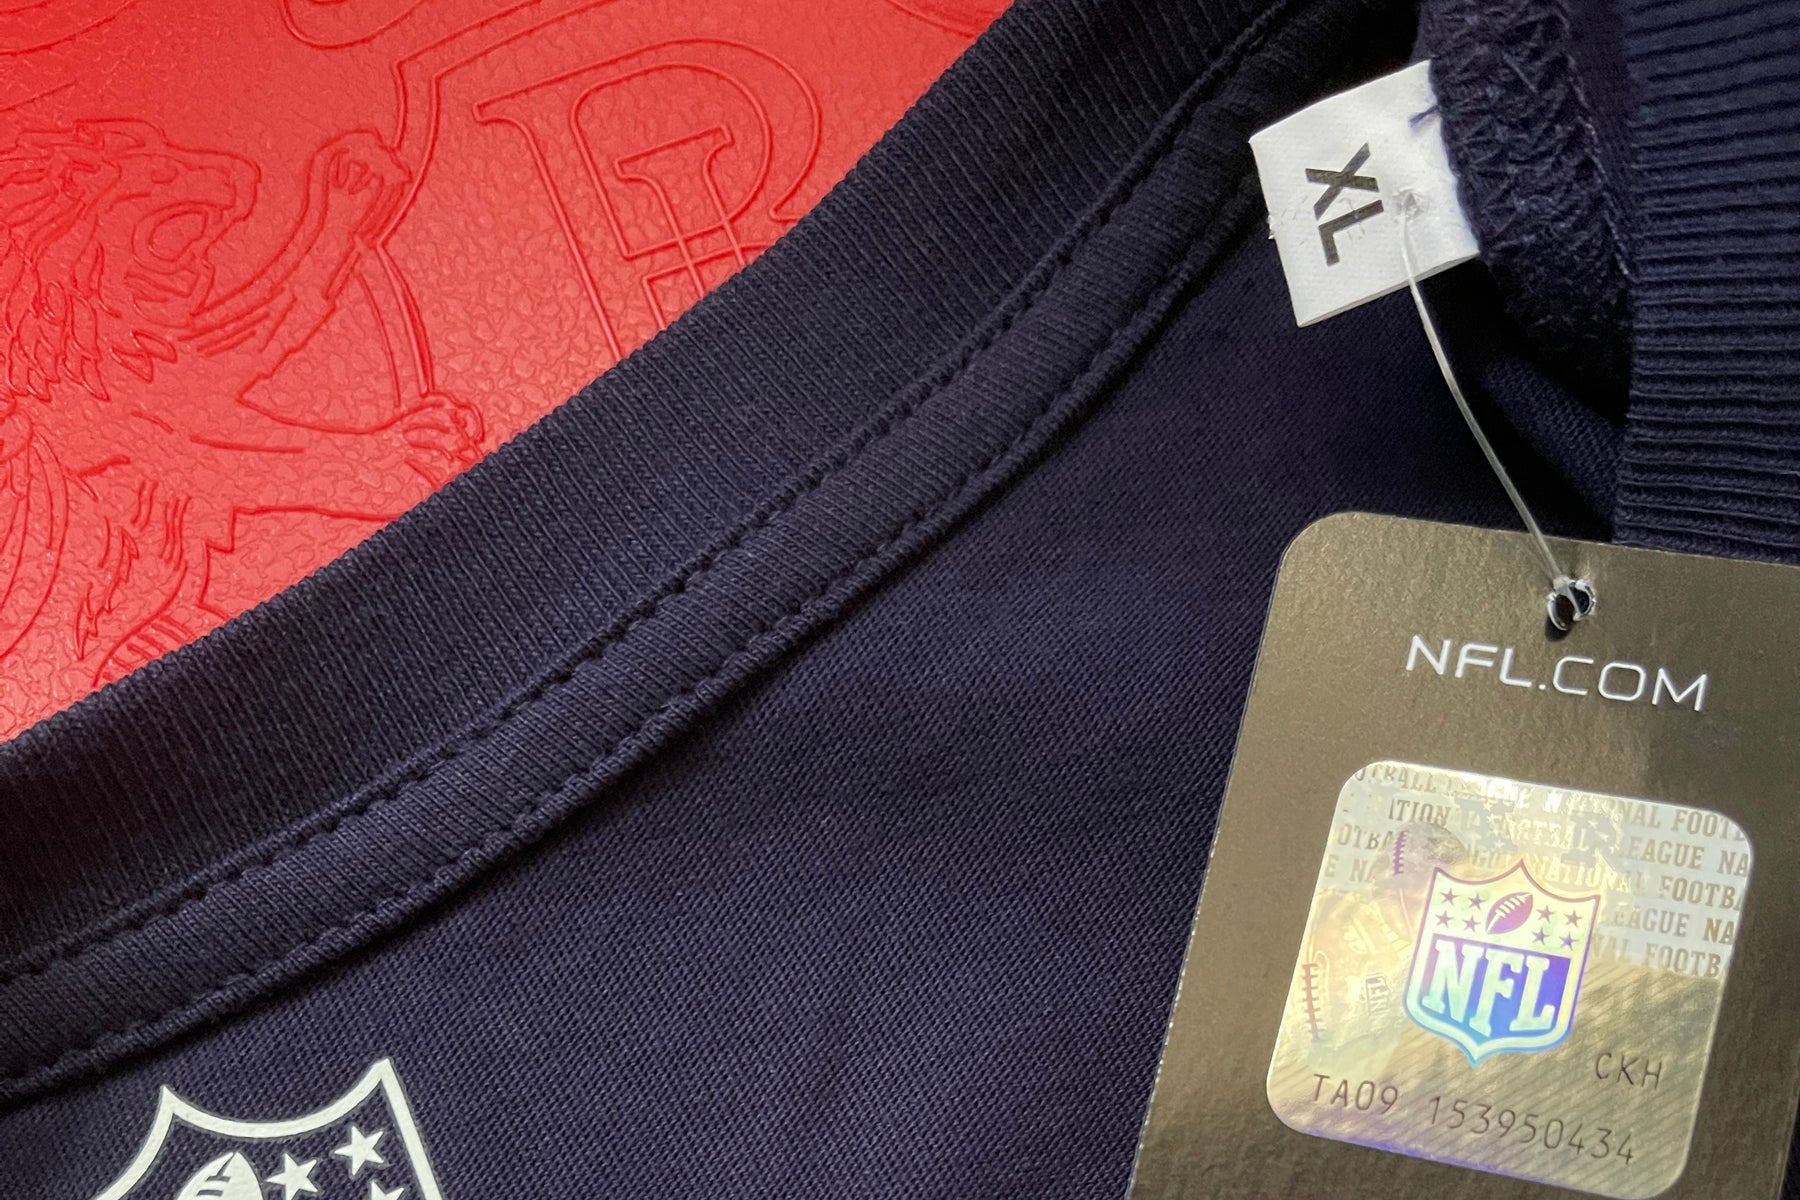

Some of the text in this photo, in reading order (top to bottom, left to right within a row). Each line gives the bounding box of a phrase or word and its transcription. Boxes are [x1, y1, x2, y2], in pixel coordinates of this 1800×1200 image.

[1304, 142, 1385, 268] XL
[1405, 634, 1708, 712] NFL.COM
[1420, 937, 1558, 1038] NFL
[1595, 1052, 1663, 1091] CKH
[1429, 1096, 1634, 1165] 153950434
